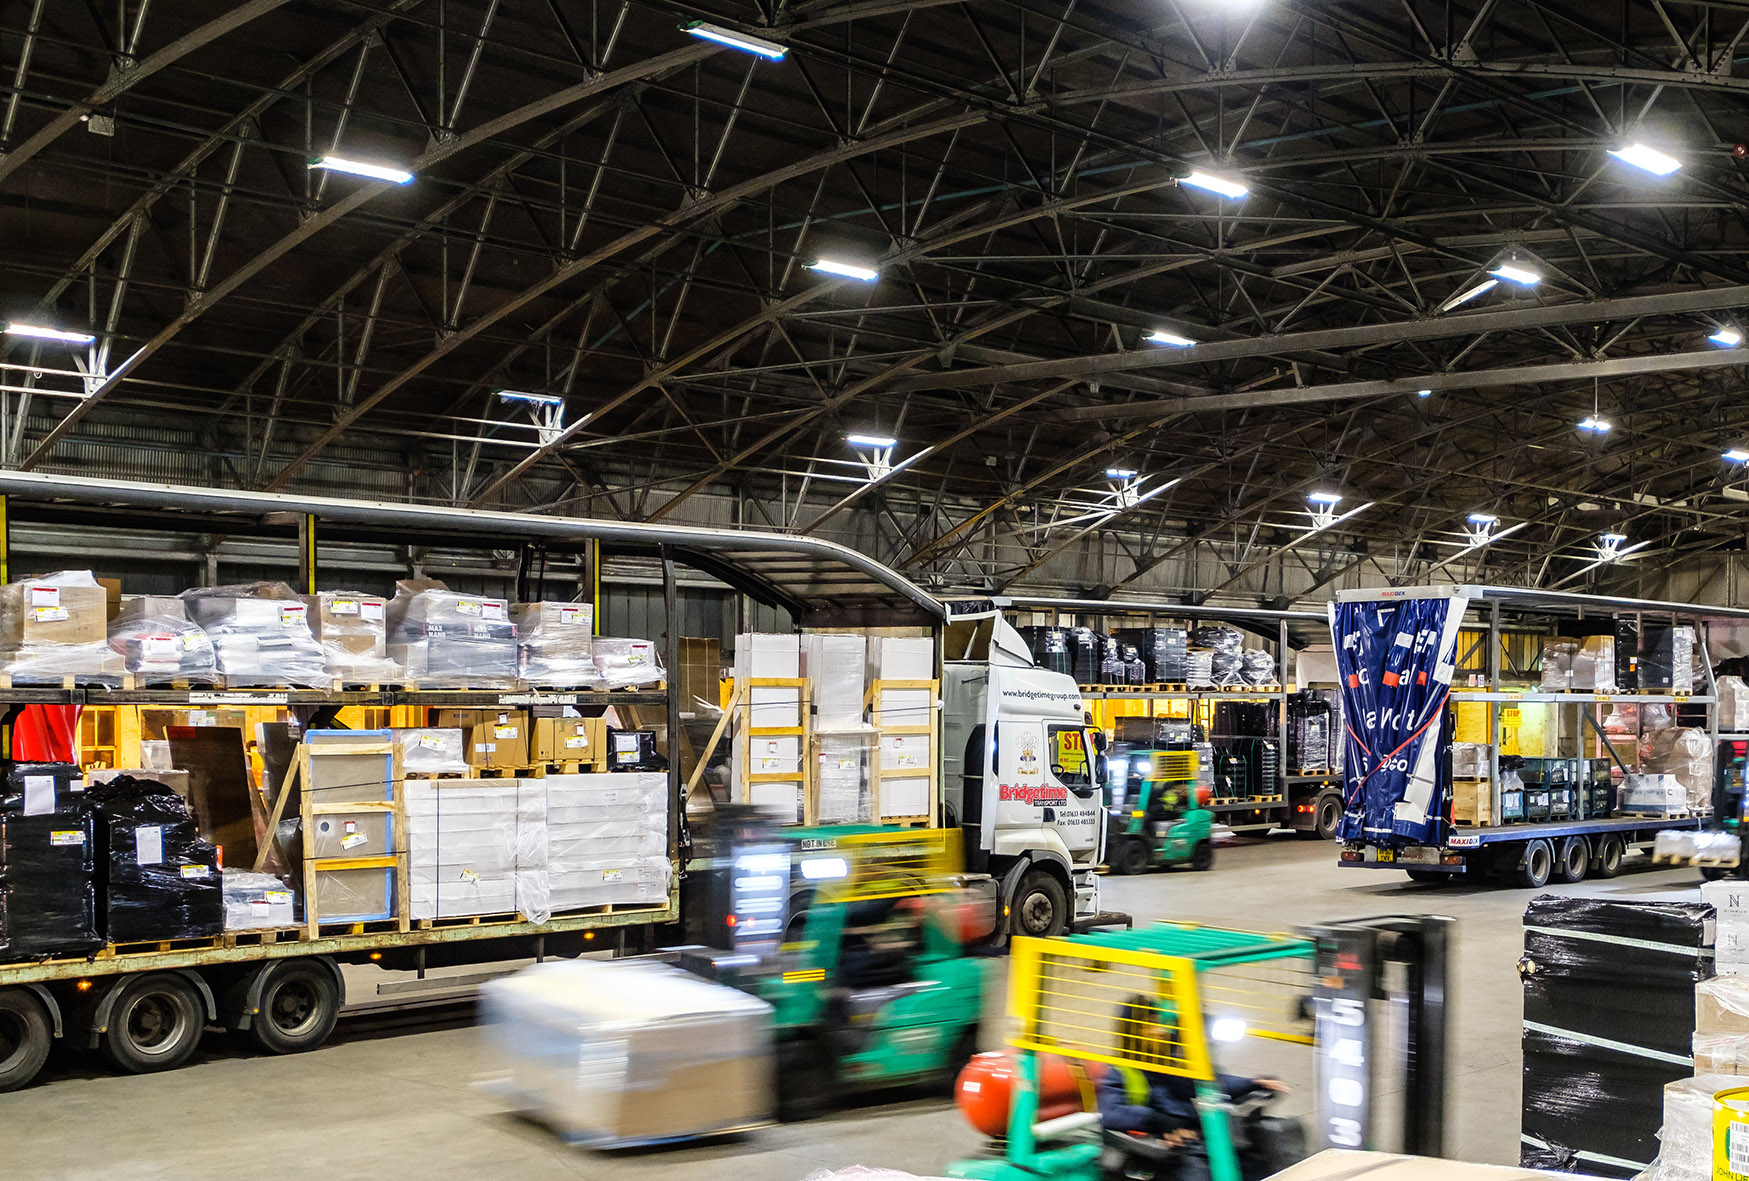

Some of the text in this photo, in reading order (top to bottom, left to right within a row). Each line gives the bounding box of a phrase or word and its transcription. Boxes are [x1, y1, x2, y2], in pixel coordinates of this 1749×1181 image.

[1002, 690, 1080, 701] www.bridgetimegroup.com
[1000, 783, 1068, 805] Bridgetime
[802, 840, 815, 848] NOT
